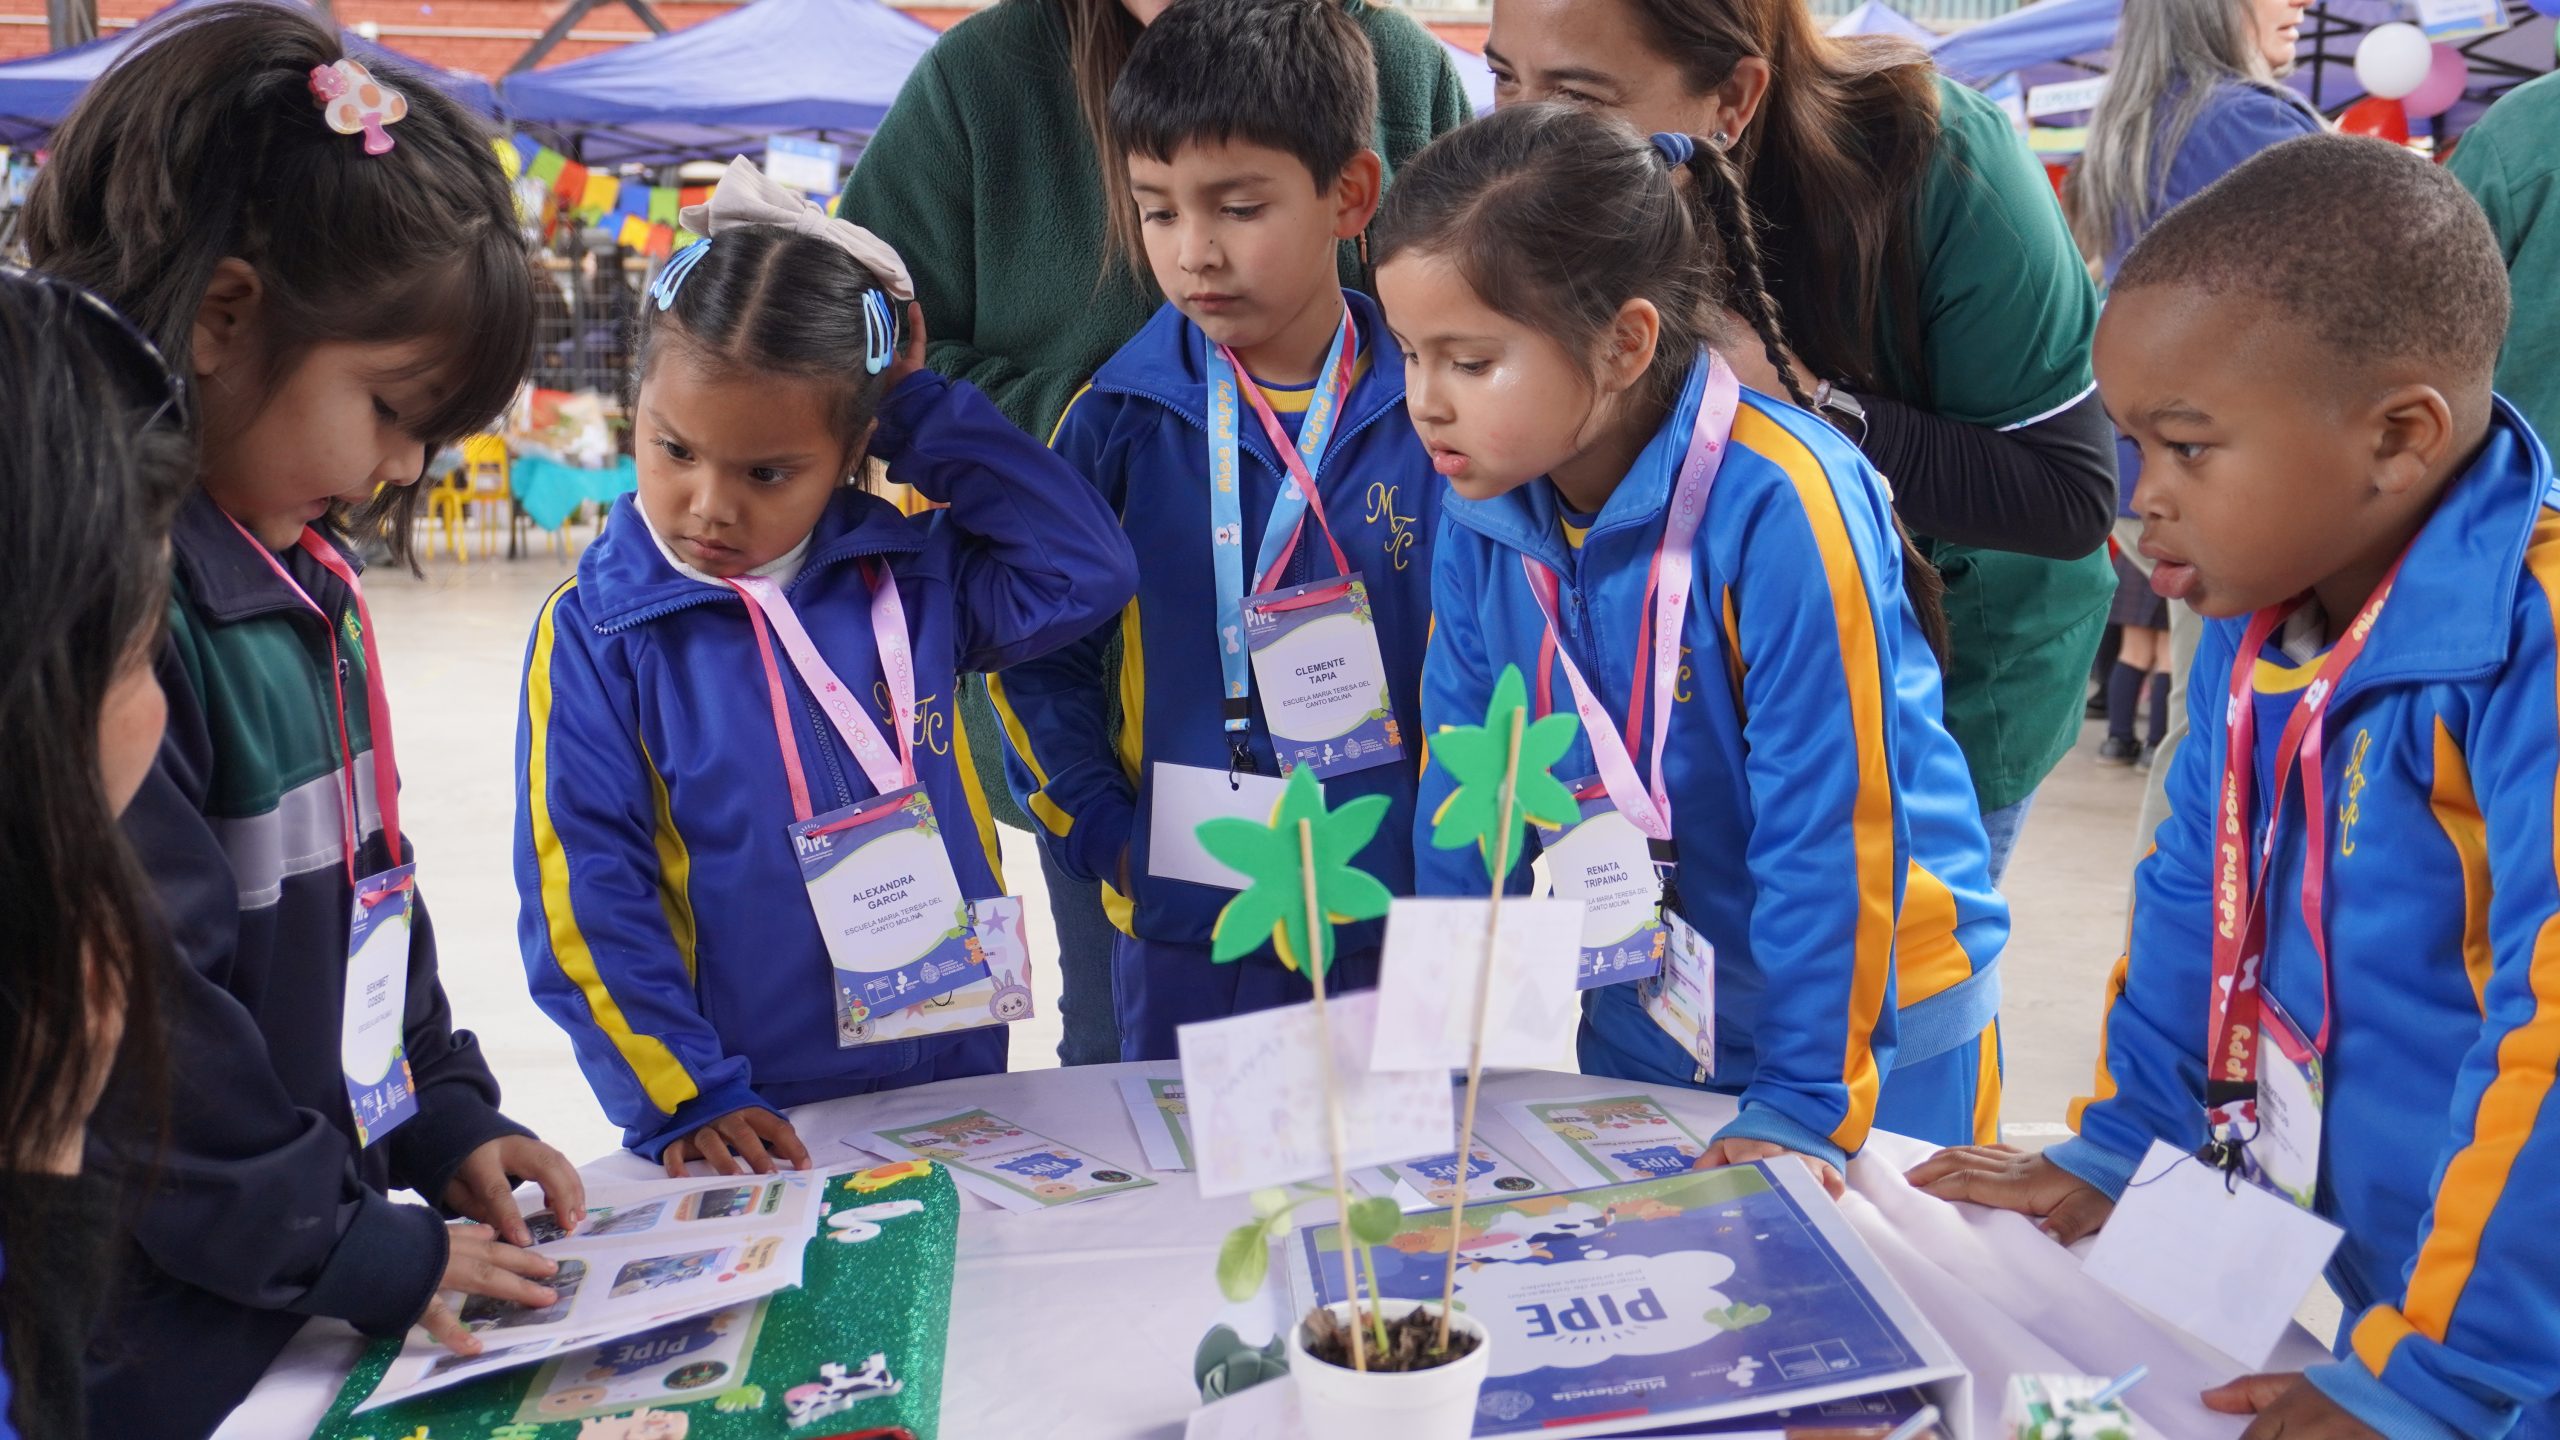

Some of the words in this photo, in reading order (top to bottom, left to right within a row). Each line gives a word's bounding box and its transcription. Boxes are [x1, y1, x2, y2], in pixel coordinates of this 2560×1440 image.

[1217, 379, 1232, 440] puppy
[1301, 396, 1333, 455] puppy
[1365, 481, 1417, 571] MTC
[1245, 607, 1277, 628] PIPE
[2352, 583, 2393, 642] Nic
[1295, 657, 1346, 677] CLEMENTE
[1308, 671, 1338, 685] TAPIA
[1282, 694, 1312, 707] ESCUELA
[1311, 689, 1333, 702] MARIA
[1333, 683, 1358, 697] TERESA
[1358, 680, 1371, 691] DEL
[1305, 697, 1328, 709] CANTO
[1327, 692, 1353, 705] MOLINA
[796, 831, 832, 857] PIPE
[1584, 872, 1629, 889] TRIPAINAO
[1586, 861, 1620, 876] RENATA
[852, 874, 916, 904] ALEXANDRA
[867, 889, 908, 911] GARCIA
[1596, 891, 1614, 904] MARIA
[1613, 888, 1637, 901] TERESA
[1637, 886, 1649, 897] DEL
[2218, 843, 2238, 939] puppy
[844, 918, 878, 936] ESCUELA
[877, 911, 900, 927] MARIA
[900, 903, 928, 919] TERESA
[928, 897, 942, 910] DEL
[1588, 901, 1608, 913] CANTO
[1608, 898, 1631, 910] MOLINA
[870, 921, 899, 935] CANTO
[899, 912, 924, 928] MOLINA
[2225, 1024, 2251, 1082] ppy
[1018, 1160, 1071, 1174] PIPE
[1428, 1161, 1481, 1177] PPE
[1631, 1156, 1685, 1169] PIPE
[1515, 1287, 1669, 1339] PIPE
[612, 1334, 690, 1363] PIPE
[1551, 1377, 1667, 1403] MinCiencia
